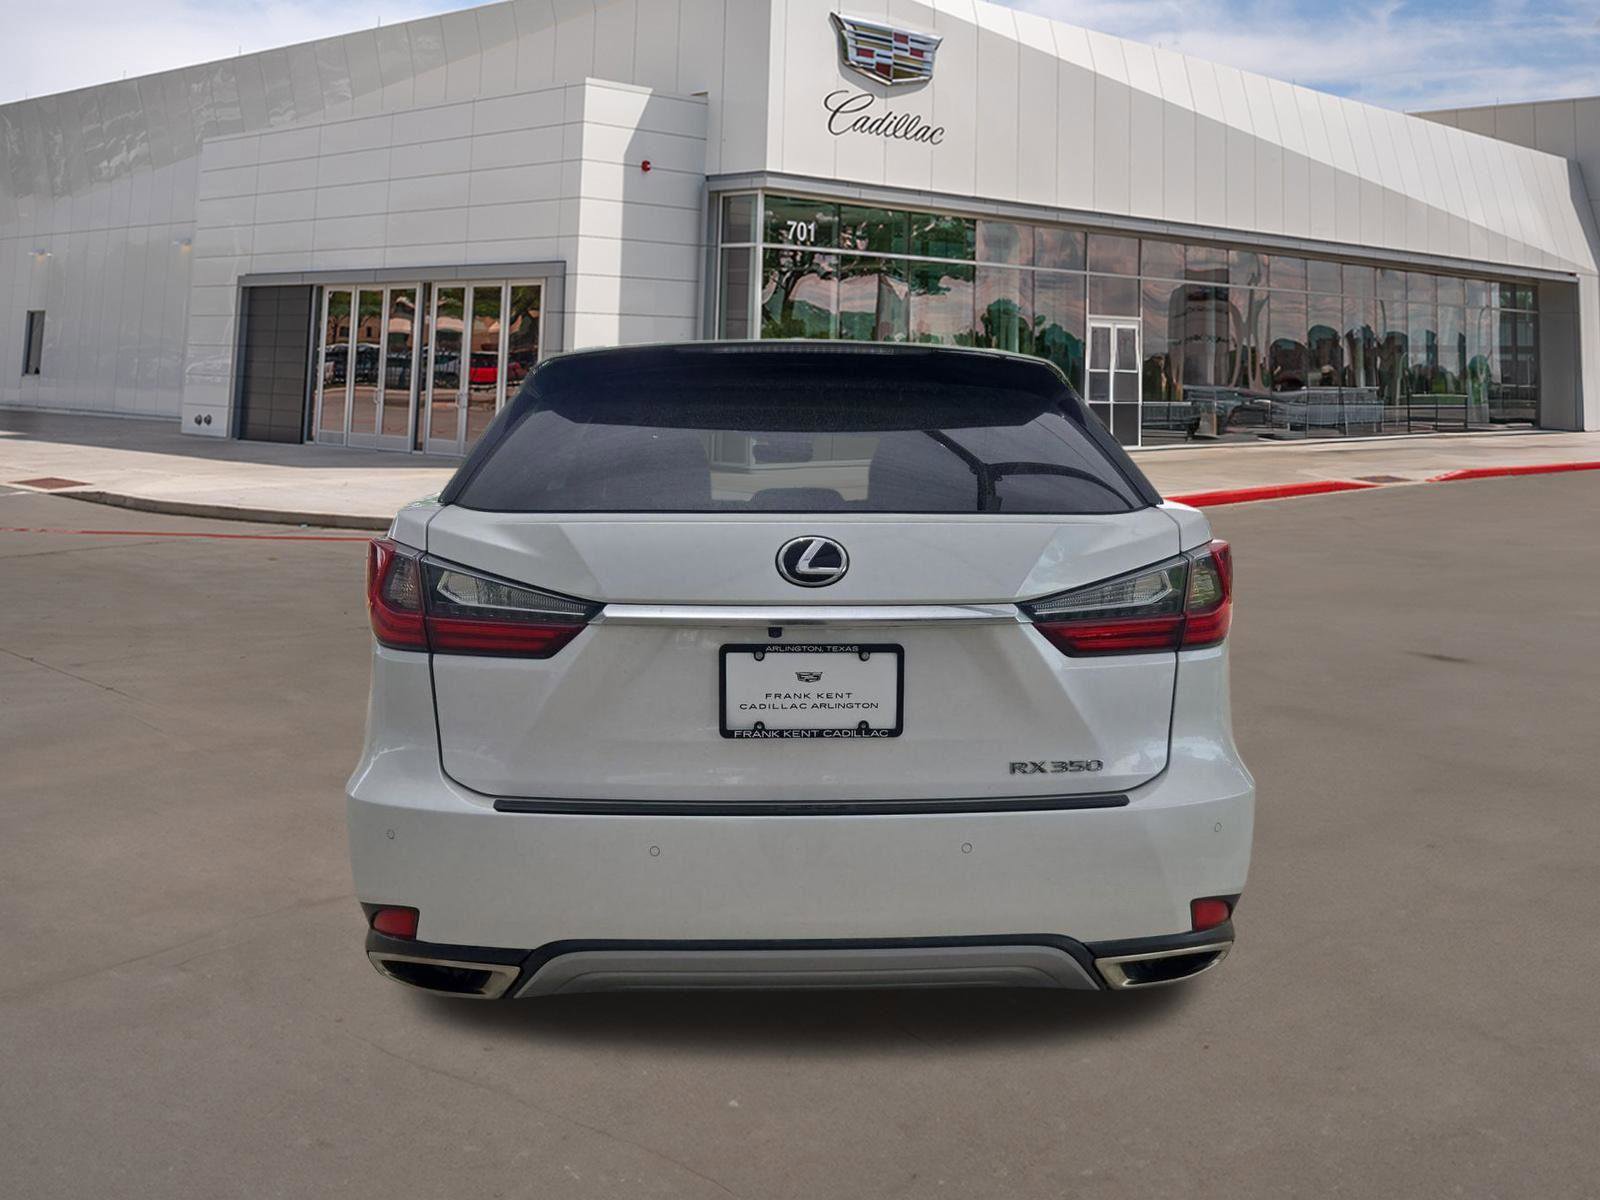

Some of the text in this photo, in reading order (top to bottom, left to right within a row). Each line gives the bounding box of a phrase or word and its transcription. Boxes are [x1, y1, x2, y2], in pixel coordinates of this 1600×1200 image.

[823, 90, 945, 145] Cadillac
[787, 220, 815, 242] 701
[765, 645, 825, 653] ARLINGTON,
[765, 692, 811, 700] FRANK
[739, 702, 808, 710] CADILLAC
[733, 730, 889, 738] FRANK KENT CADILLAC
